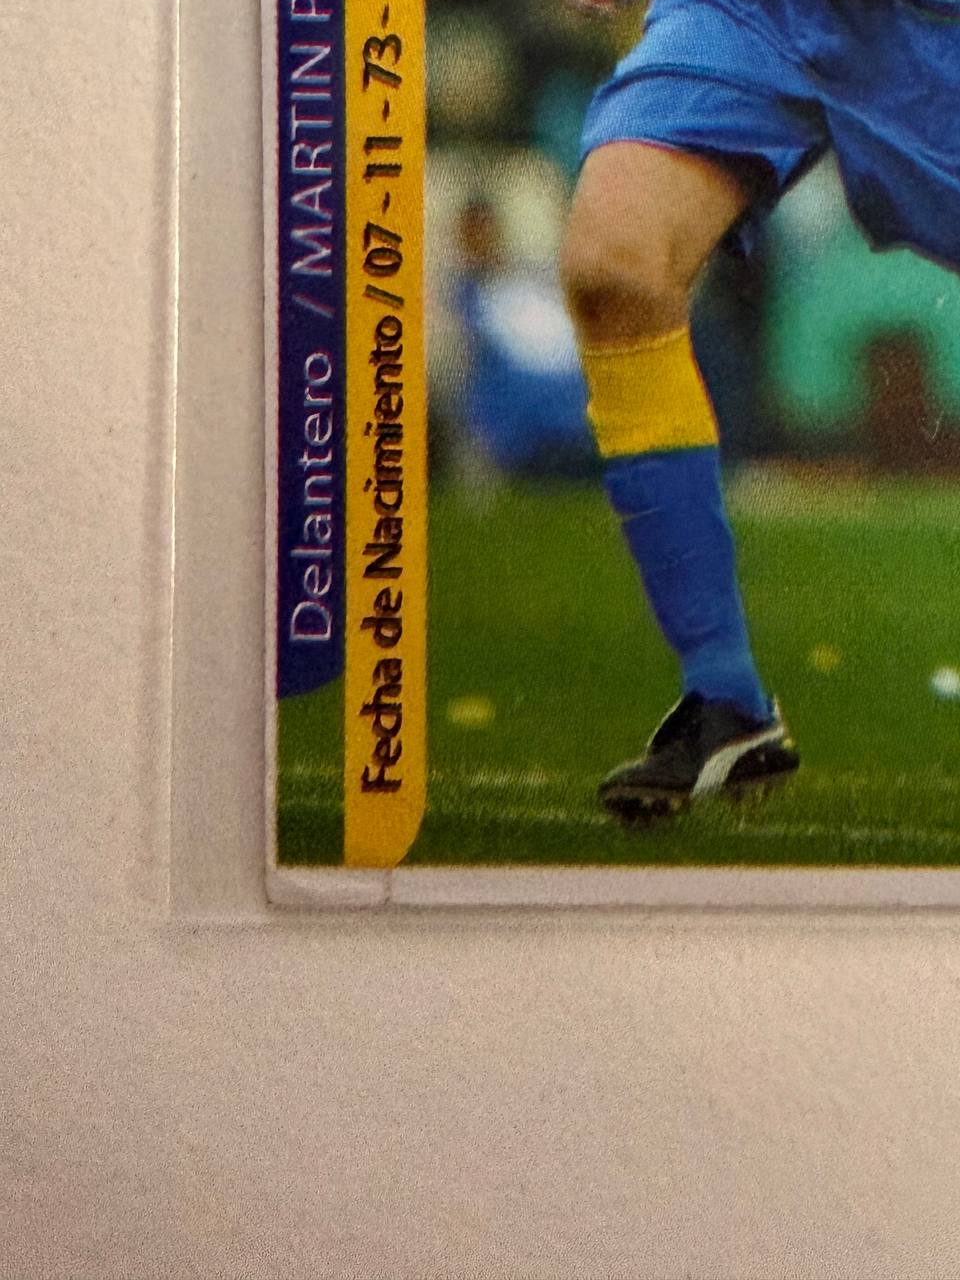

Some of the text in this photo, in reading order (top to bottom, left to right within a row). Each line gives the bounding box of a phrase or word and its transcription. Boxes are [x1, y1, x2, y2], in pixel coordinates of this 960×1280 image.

[289, 45, 333, 276] MARTIN
[290, 351, 334, 642] Delantero
[362, 316, 404, 580] Nacimiento
[360, 587, 404, 649] de
[360, 659, 404, 794] Fecha
